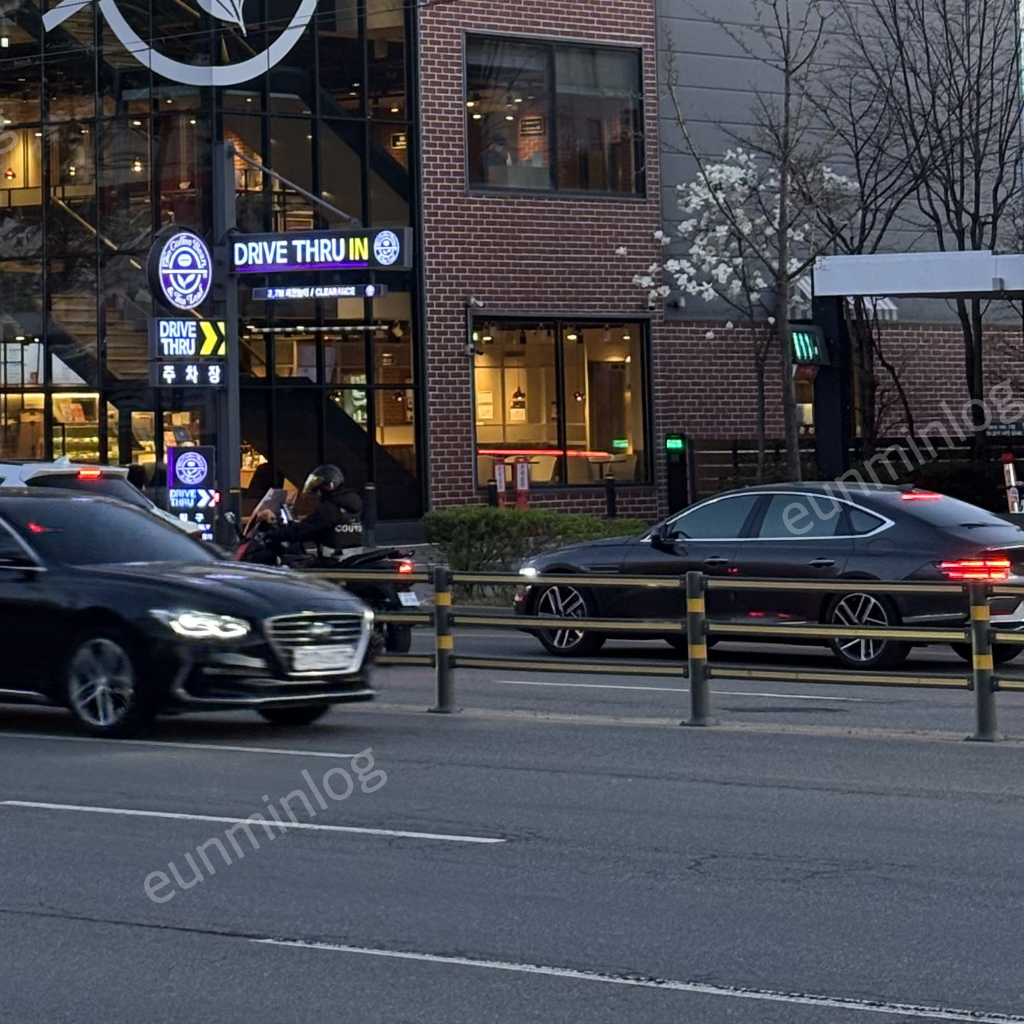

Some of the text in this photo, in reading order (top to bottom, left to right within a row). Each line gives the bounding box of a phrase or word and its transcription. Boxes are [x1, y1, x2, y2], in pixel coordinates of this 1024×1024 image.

[234, 240, 288, 266] DRIVE
[292, 238, 346, 263] THRU
[349, 237, 369, 261] IN
[159, 321, 197, 338] DRIVE
[160, 338, 196, 356] THRU
[162, 365, 220, 384] 주차장
[169, 489, 196, 498] DRIVE
[170, 498, 194, 507] THRU
